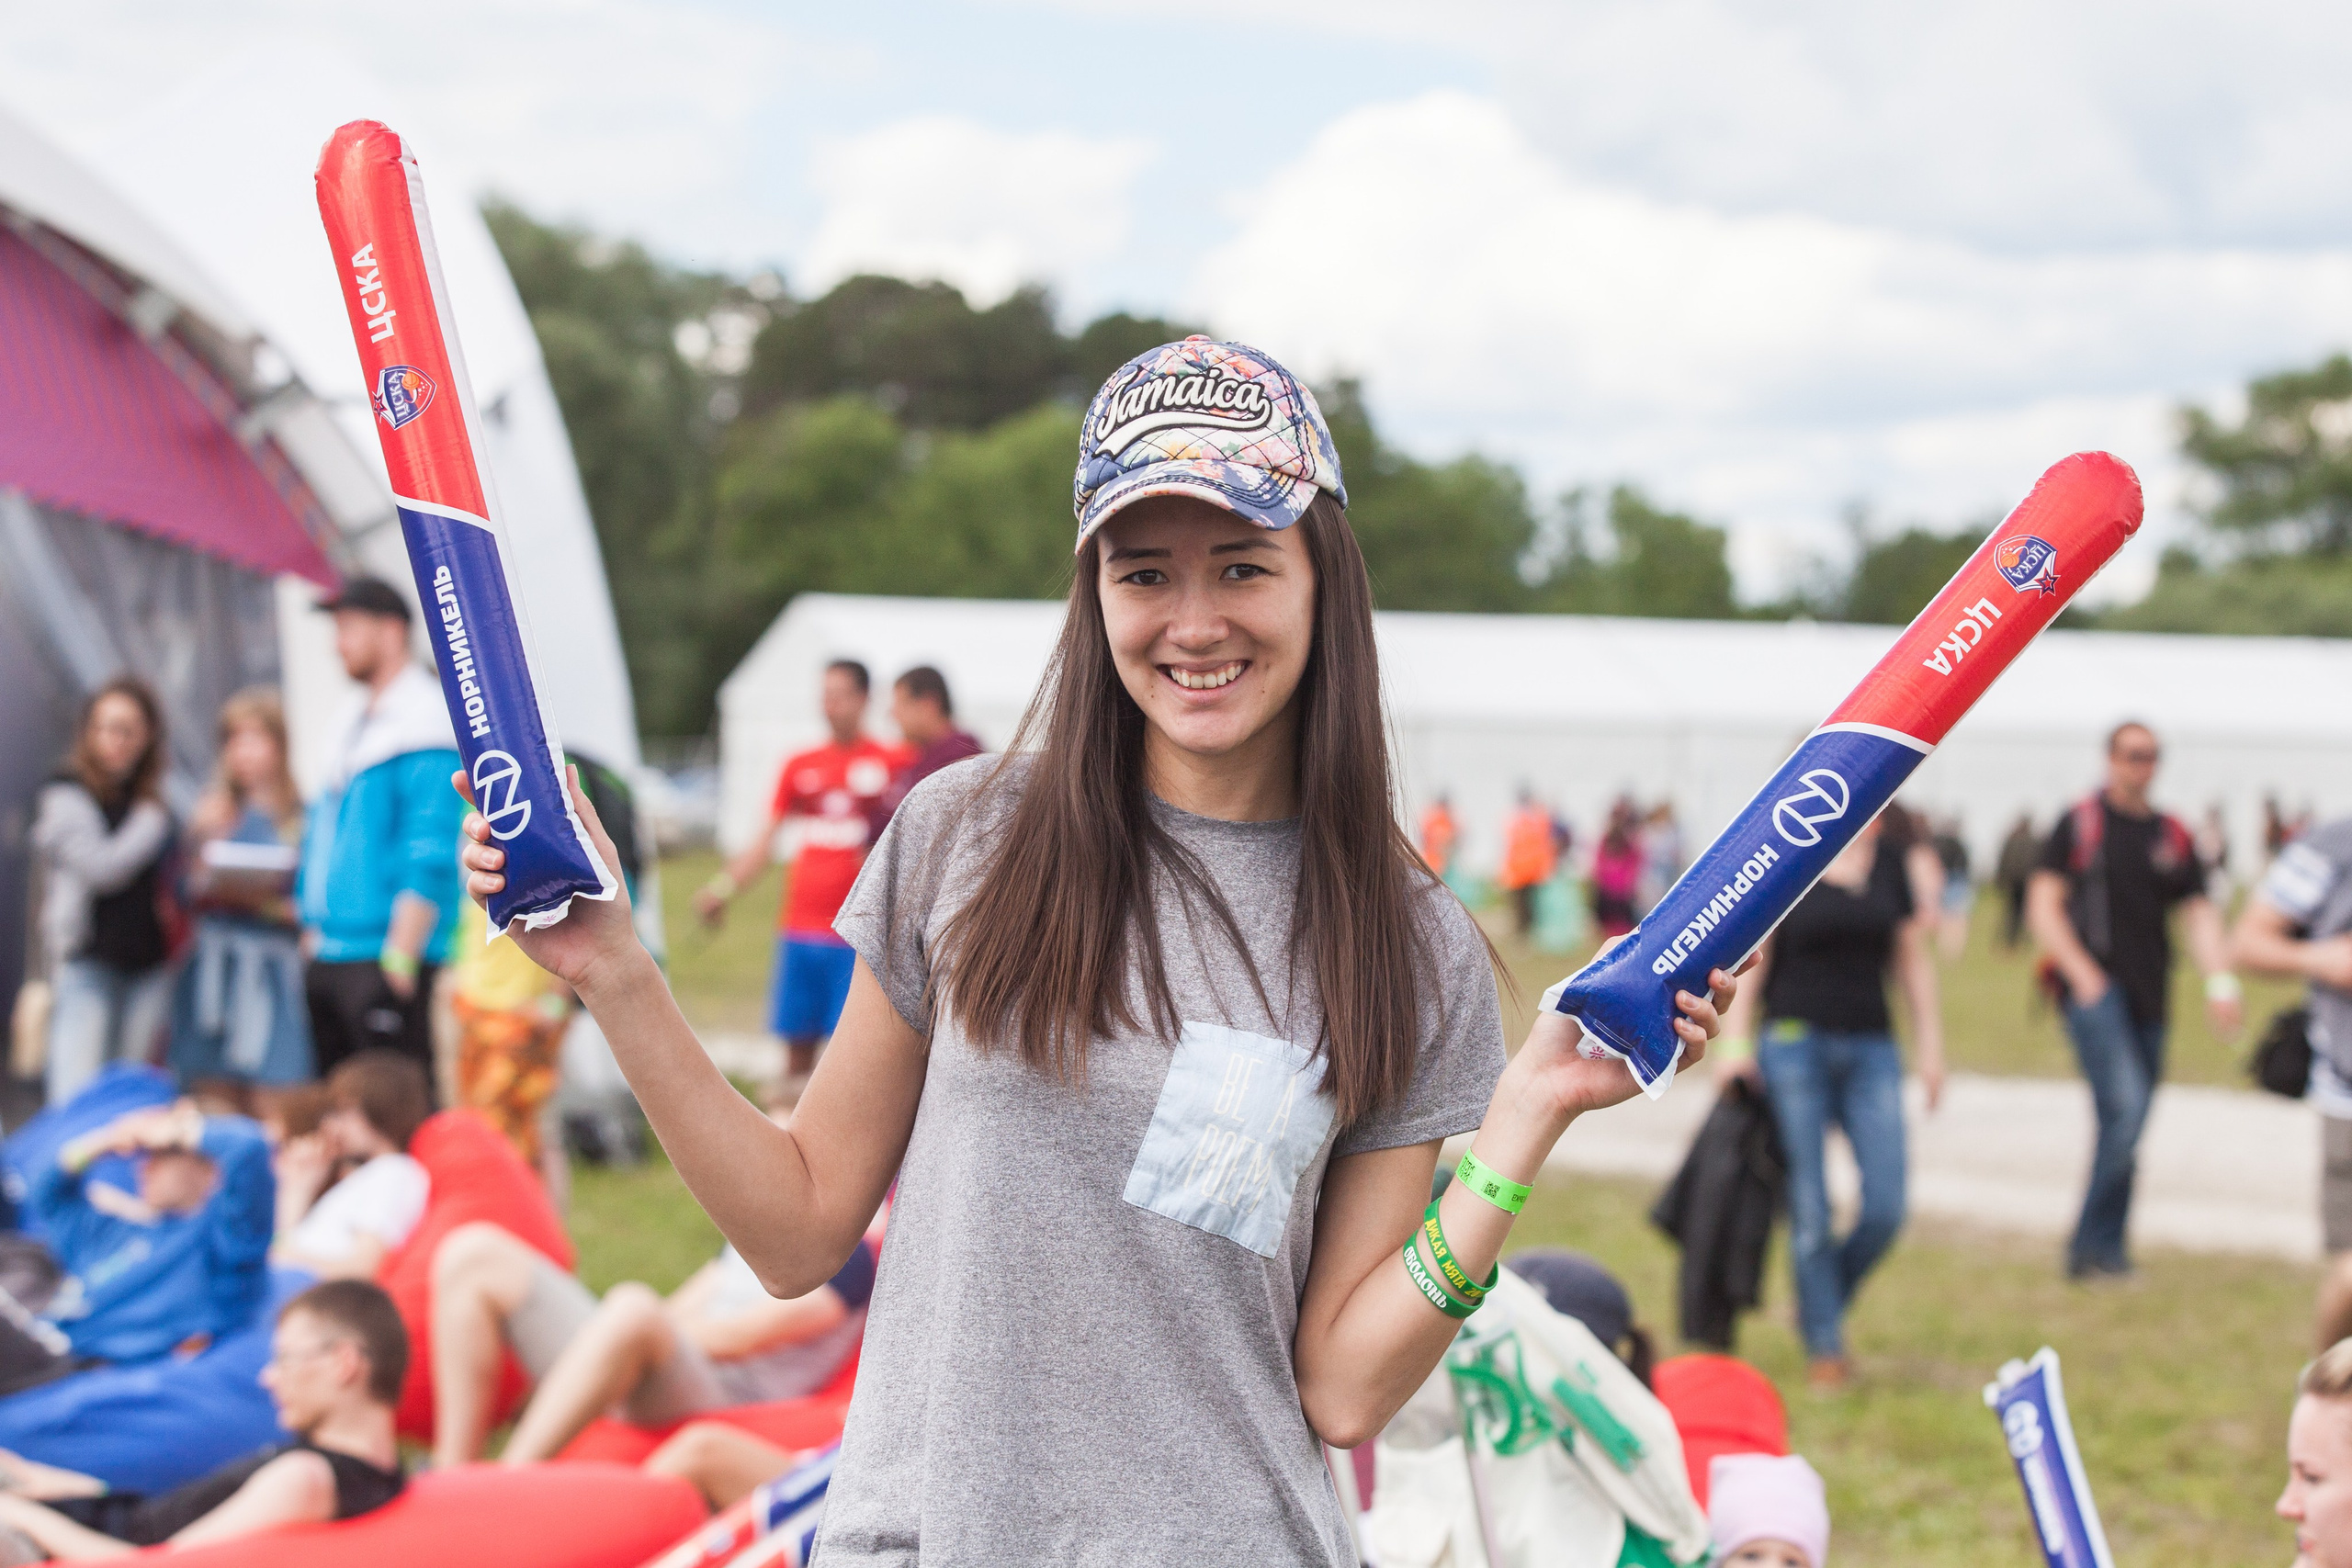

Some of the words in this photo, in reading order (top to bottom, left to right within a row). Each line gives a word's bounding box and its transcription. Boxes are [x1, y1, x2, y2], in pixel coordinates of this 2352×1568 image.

[352, 243, 396, 343] ЦСКА
[388, 371, 412, 419] ЦСКА
[1095, 367, 1270, 441] Jamaica
[2011, 544, 2047, 580] ЦСКА
[433, 565, 491, 739] НОРНИКЕЛЬ
[1922, 597, 2003, 676] ЦСКА
[1652, 843, 1780, 975] НОРНИКЕЛЬ
[1213, 1052, 1263, 1122] BE
[1267, 1075, 1297, 1140] A
[1184, 1122, 1275, 1214] POEM
[1403, 1246, 1447, 1308] ОБОЛОНЬ
[1424, 1217, 1447, 1258] ДИКАЯ
[1442, 1260, 1467, 1289] МЯТА
